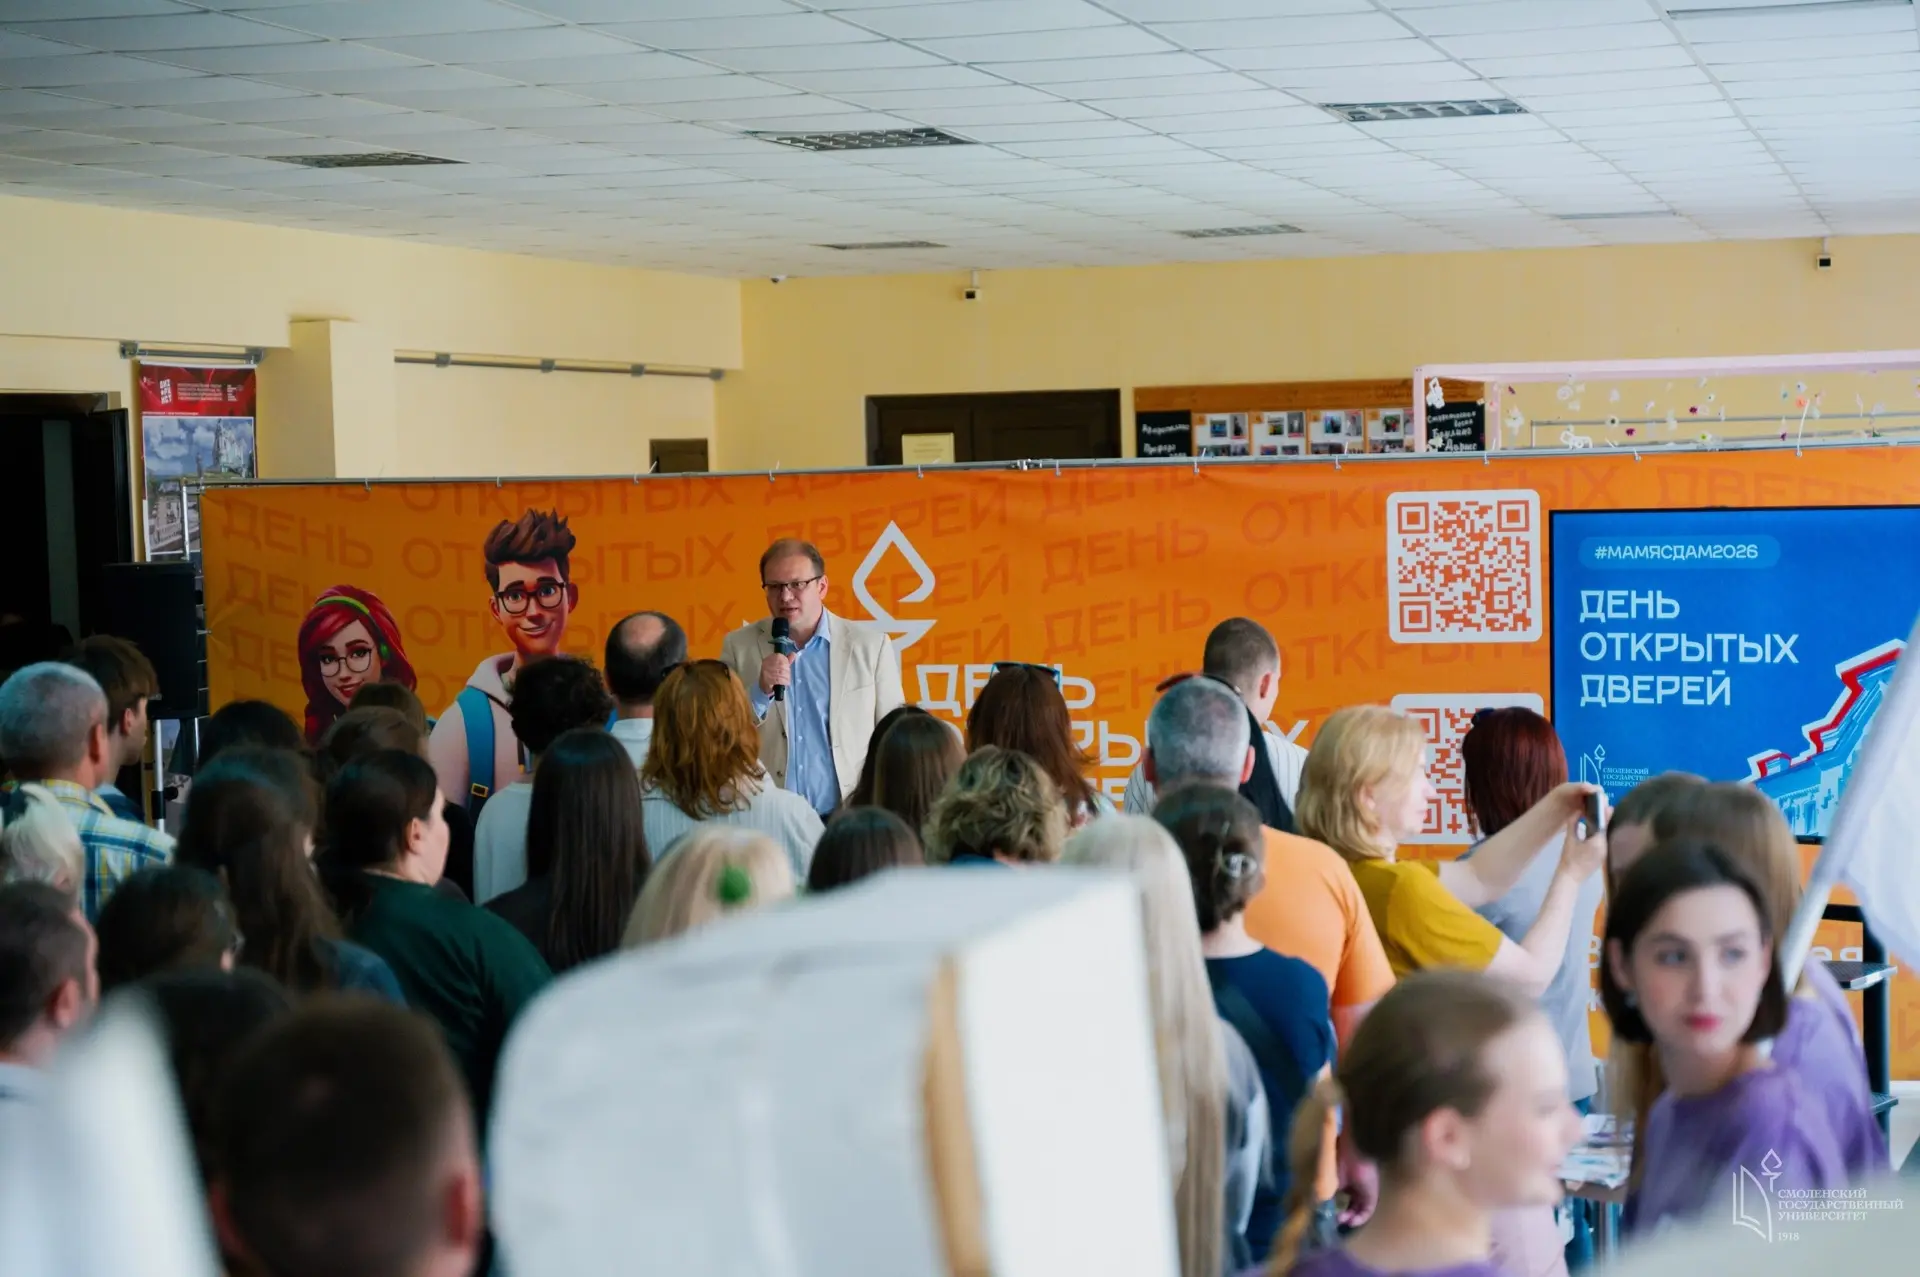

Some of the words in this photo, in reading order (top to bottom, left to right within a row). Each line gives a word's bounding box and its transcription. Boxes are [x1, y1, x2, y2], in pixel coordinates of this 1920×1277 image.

[222, 497, 374, 570] ДЕНЬ
[402, 531, 736, 587] ОТЫТЫХ
[1041, 518, 1209, 594] ДЕНЬ
[1595, 544, 1759, 561] #МАМЯСДАМ2026
[1580, 590, 1680, 623] ДЕНЬ
[1042, 588, 1212, 664] ДЕНЬ
[1580, 632, 1799, 664] ОТКРЫТЫХ
[916, 664, 1096, 717] ДЕЬ
[1580, 670, 1731, 707] ДВЕРЕЙ
[1603, 767, 1649, 775] СМОЛЕНСКИЙ
